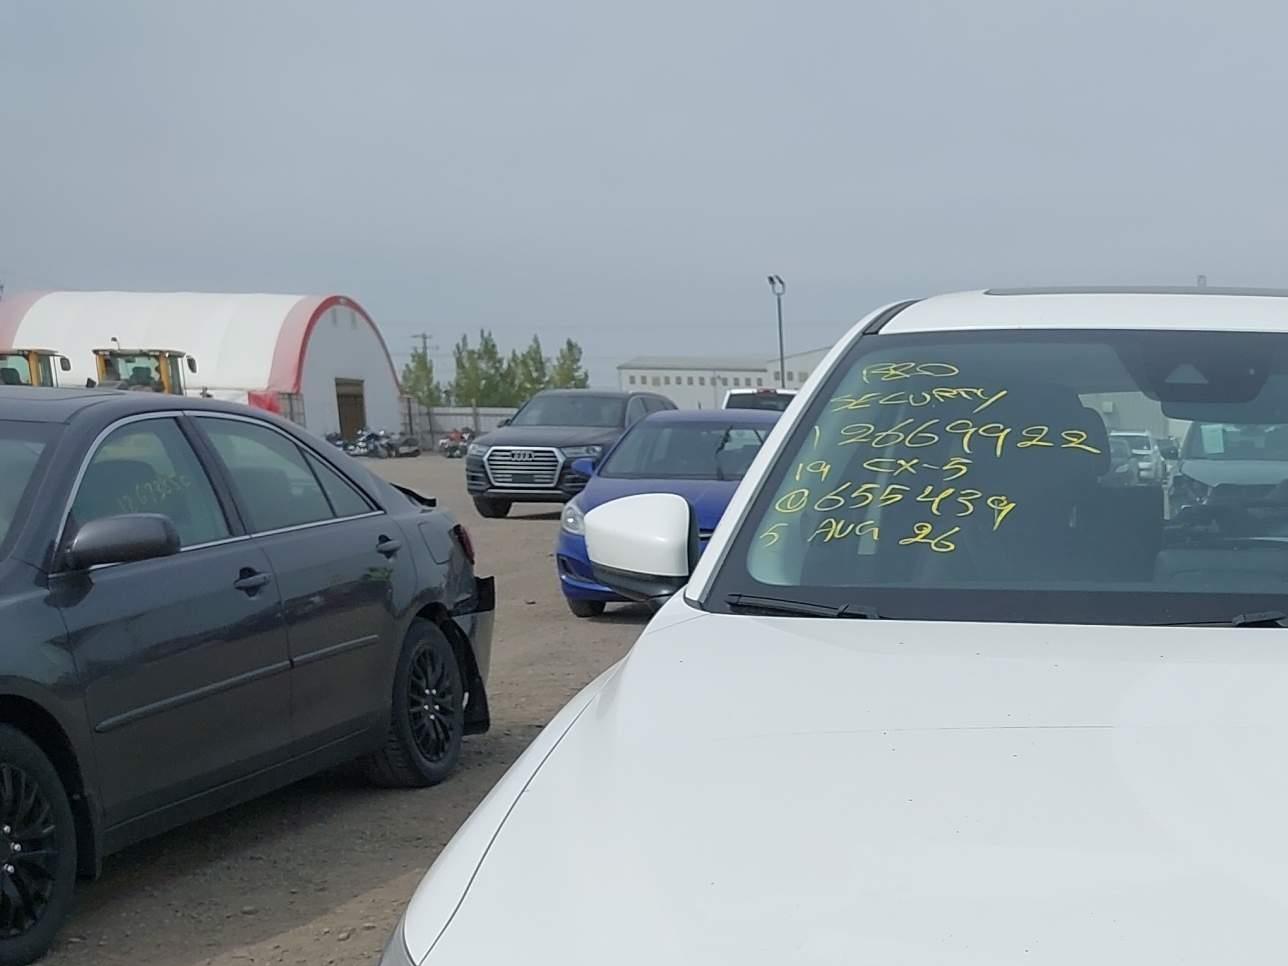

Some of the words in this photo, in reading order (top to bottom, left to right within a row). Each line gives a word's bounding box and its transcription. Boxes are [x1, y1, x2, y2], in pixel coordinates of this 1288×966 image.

[795, 461, 831, 481] 19
[862, 457, 973, 481] CX-5
[807, 518, 880, 543] AUG
[898, 522, 961, 552] 26
